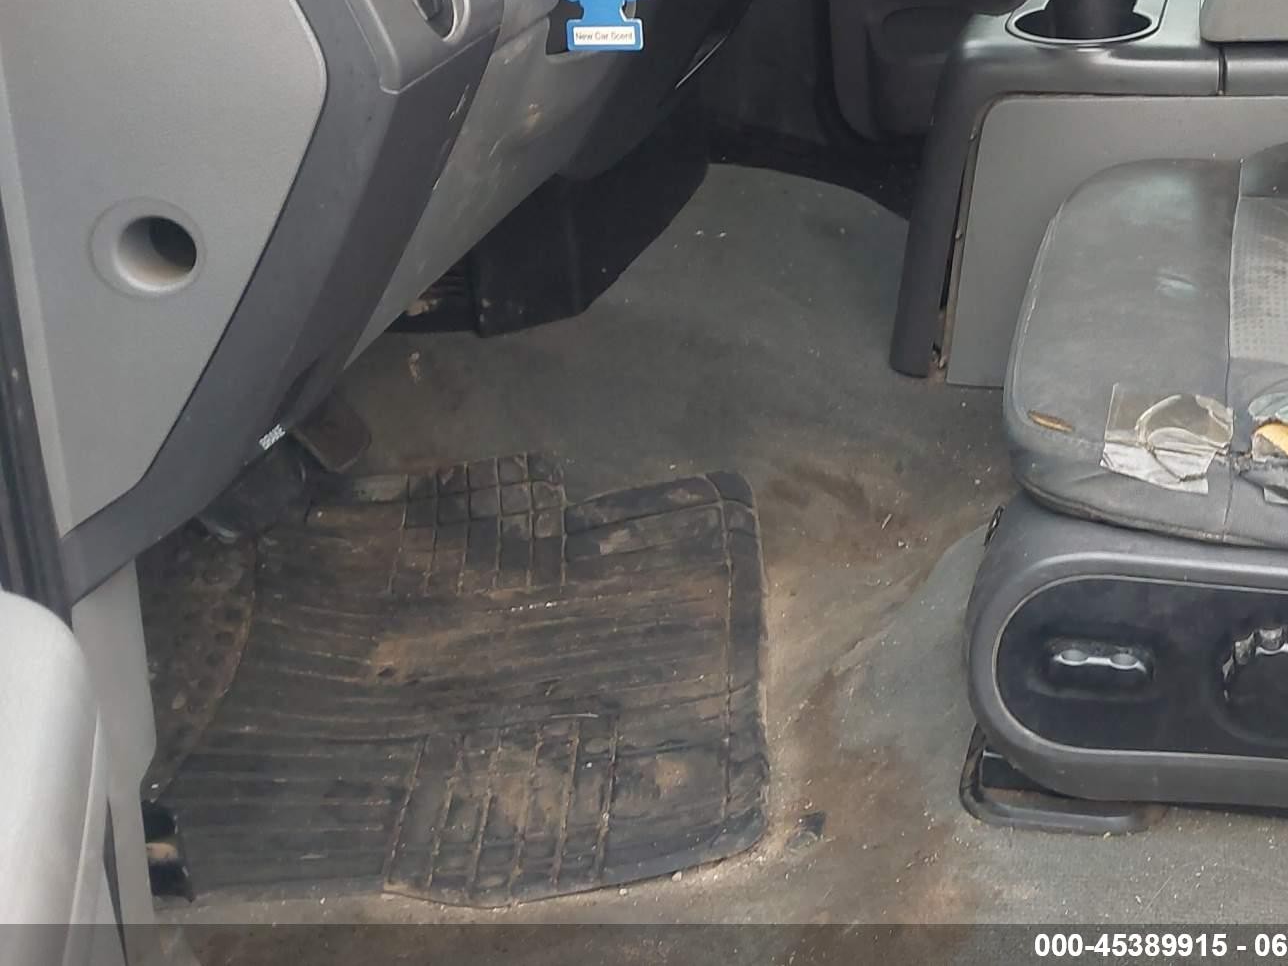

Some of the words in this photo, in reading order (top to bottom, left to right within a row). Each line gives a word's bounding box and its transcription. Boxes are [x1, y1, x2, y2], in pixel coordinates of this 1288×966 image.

[575, 31, 593, 41] New
[594, 30, 609, 41] Car
[610, 30, 633, 41] Scent
